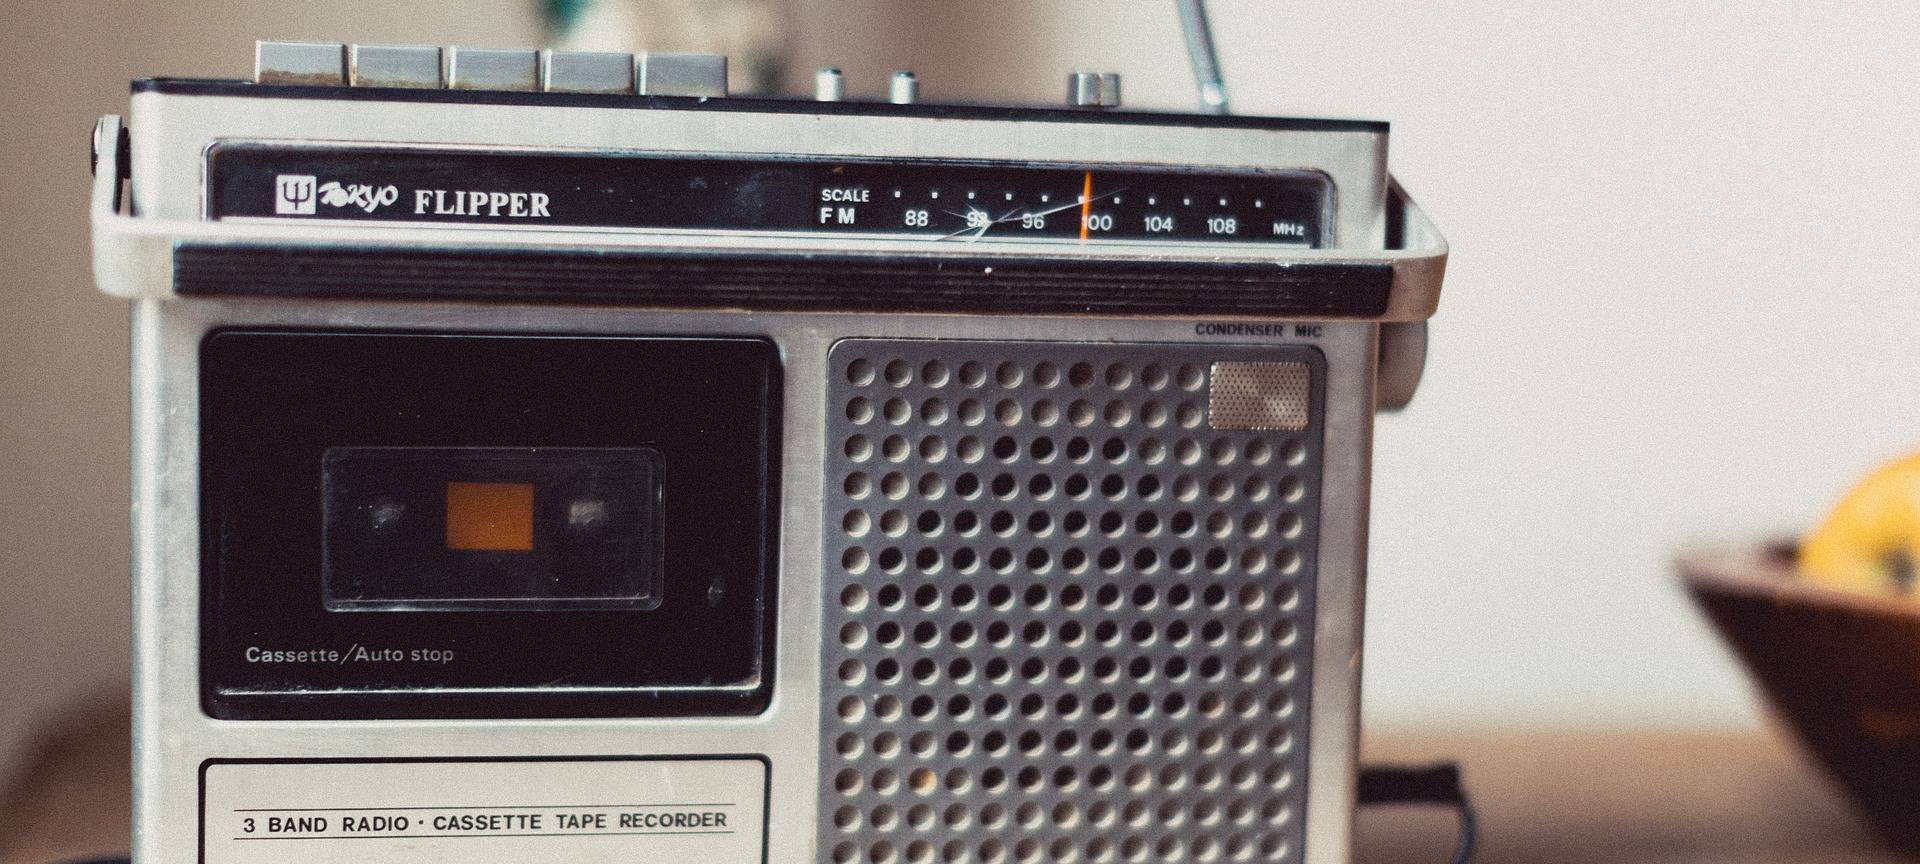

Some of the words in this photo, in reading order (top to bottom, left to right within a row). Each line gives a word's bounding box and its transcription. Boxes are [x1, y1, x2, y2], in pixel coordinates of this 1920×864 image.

[414, 190, 551, 217] FLIPPER
[821, 189, 870, 202] SCALE
[904, 210, 928, 227] 88
[1022, 213, 1045, 229] 96
[1143, 216, 1173, 232] 104
[1207, 218, 1236, 234] 108
[1272, 222, 1304, 236] MHz
[1195, 324, 1283, 336] CONDENSER
[1295, 325, 1322, 337] MIC
[411, 647, 454, 665] stop
[243, 818, 255, 832] 3
[268, 817, 328, 832] BAND
[342, 815, 409, 832] RADIO
[433, 814, 542, 831] CASSETTE
[556, 814, 607, 829] TAPE
[619, 812, 727, 828] RECORDER
